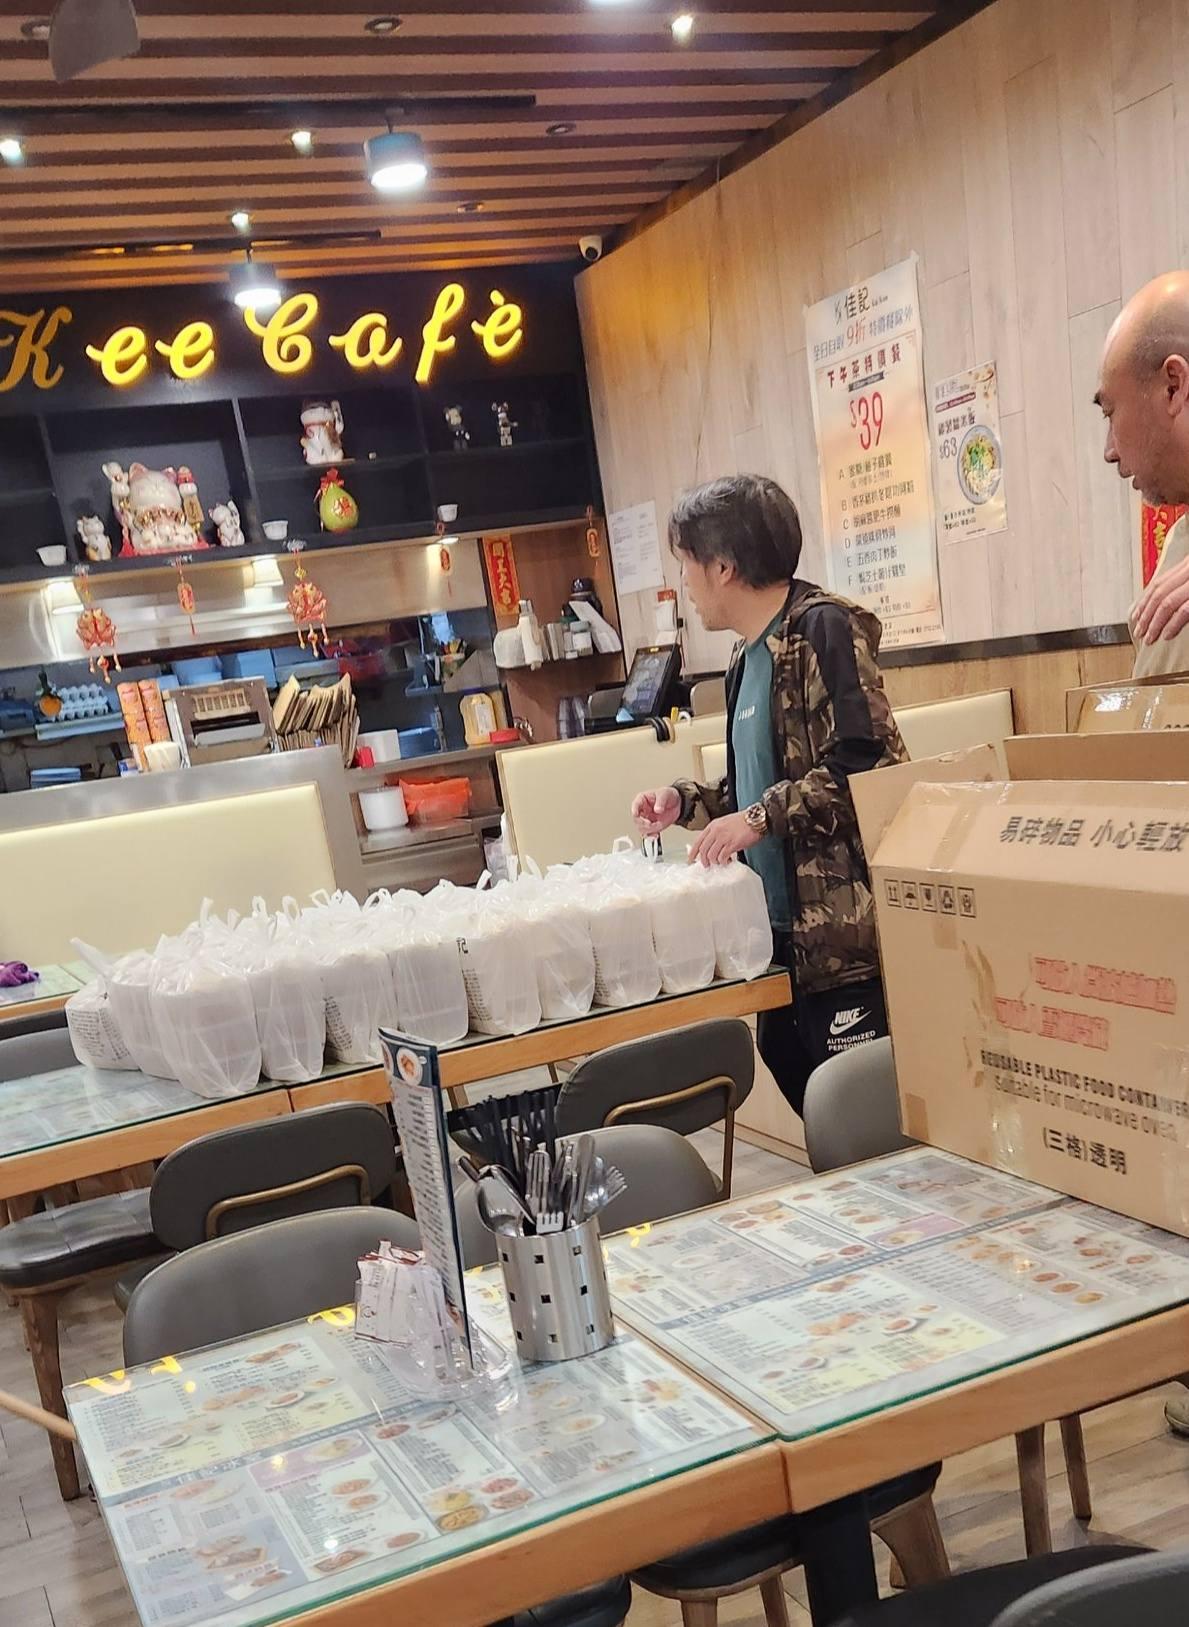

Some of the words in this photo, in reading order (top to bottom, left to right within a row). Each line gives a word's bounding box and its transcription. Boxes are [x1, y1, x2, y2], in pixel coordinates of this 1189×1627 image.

[1000, 816, 1085, 847] 易碎物品
[834, 1007, 861, 1025] NIKE
[827, 1029, 876, 1045] AUTHORIZED
[1034, 1063, 1081, 1090] PLASTIC
[1084, 1075, 1115, 1098] FOOD
